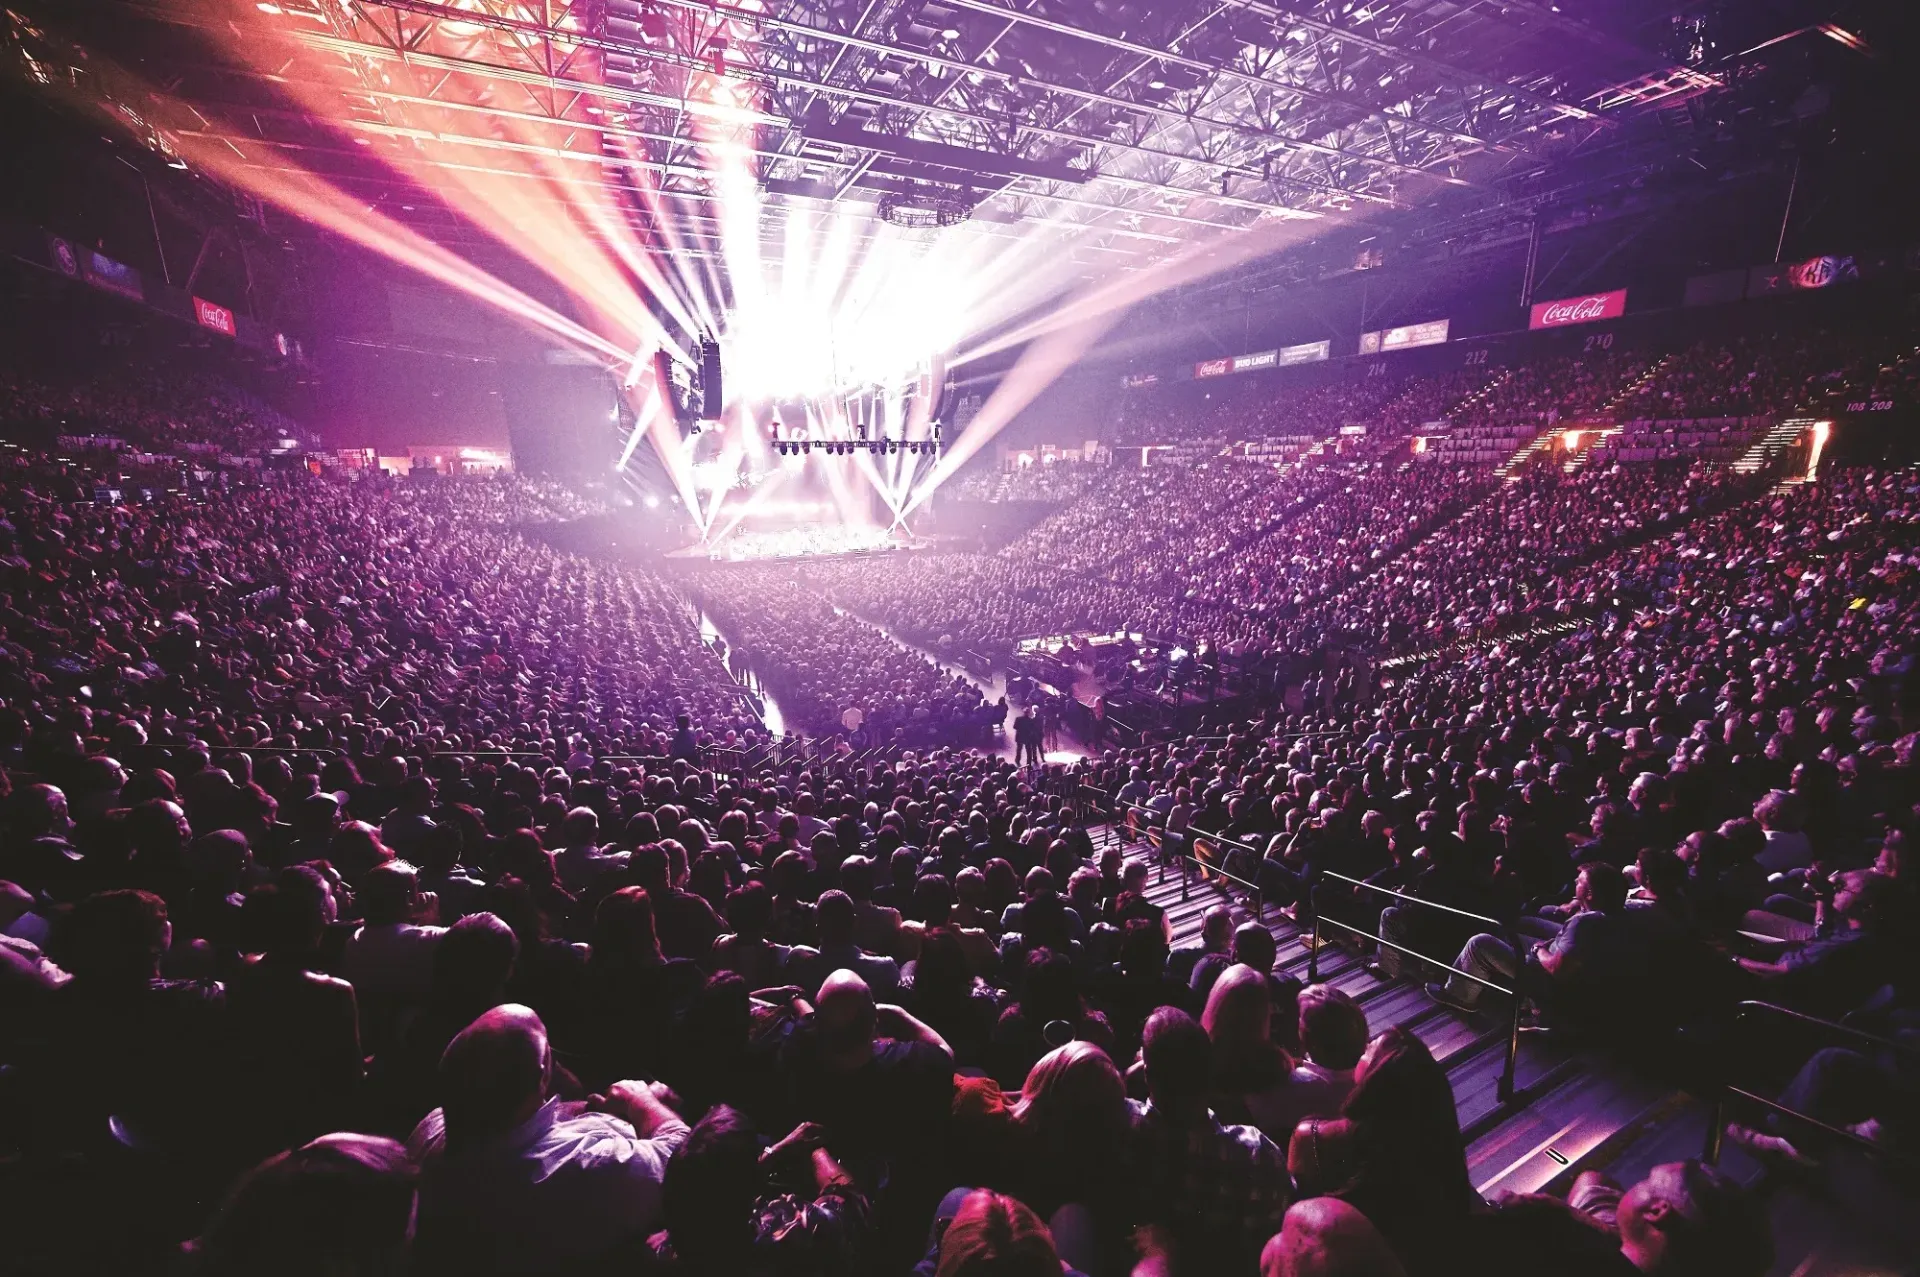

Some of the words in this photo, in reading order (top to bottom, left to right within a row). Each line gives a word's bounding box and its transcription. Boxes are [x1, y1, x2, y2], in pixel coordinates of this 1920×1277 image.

[1583, 333, 1614, 352] 210
[1235, 358, 1251, 368] BUD
[1251, 354, 1275, 365] LIGHT
[1464, 349, 1489, 365] 212
[1367, 362, 1387, 377] 214
[1846, 402, 1866, 412] 108
[1870, 400, 1894, 411] 208
